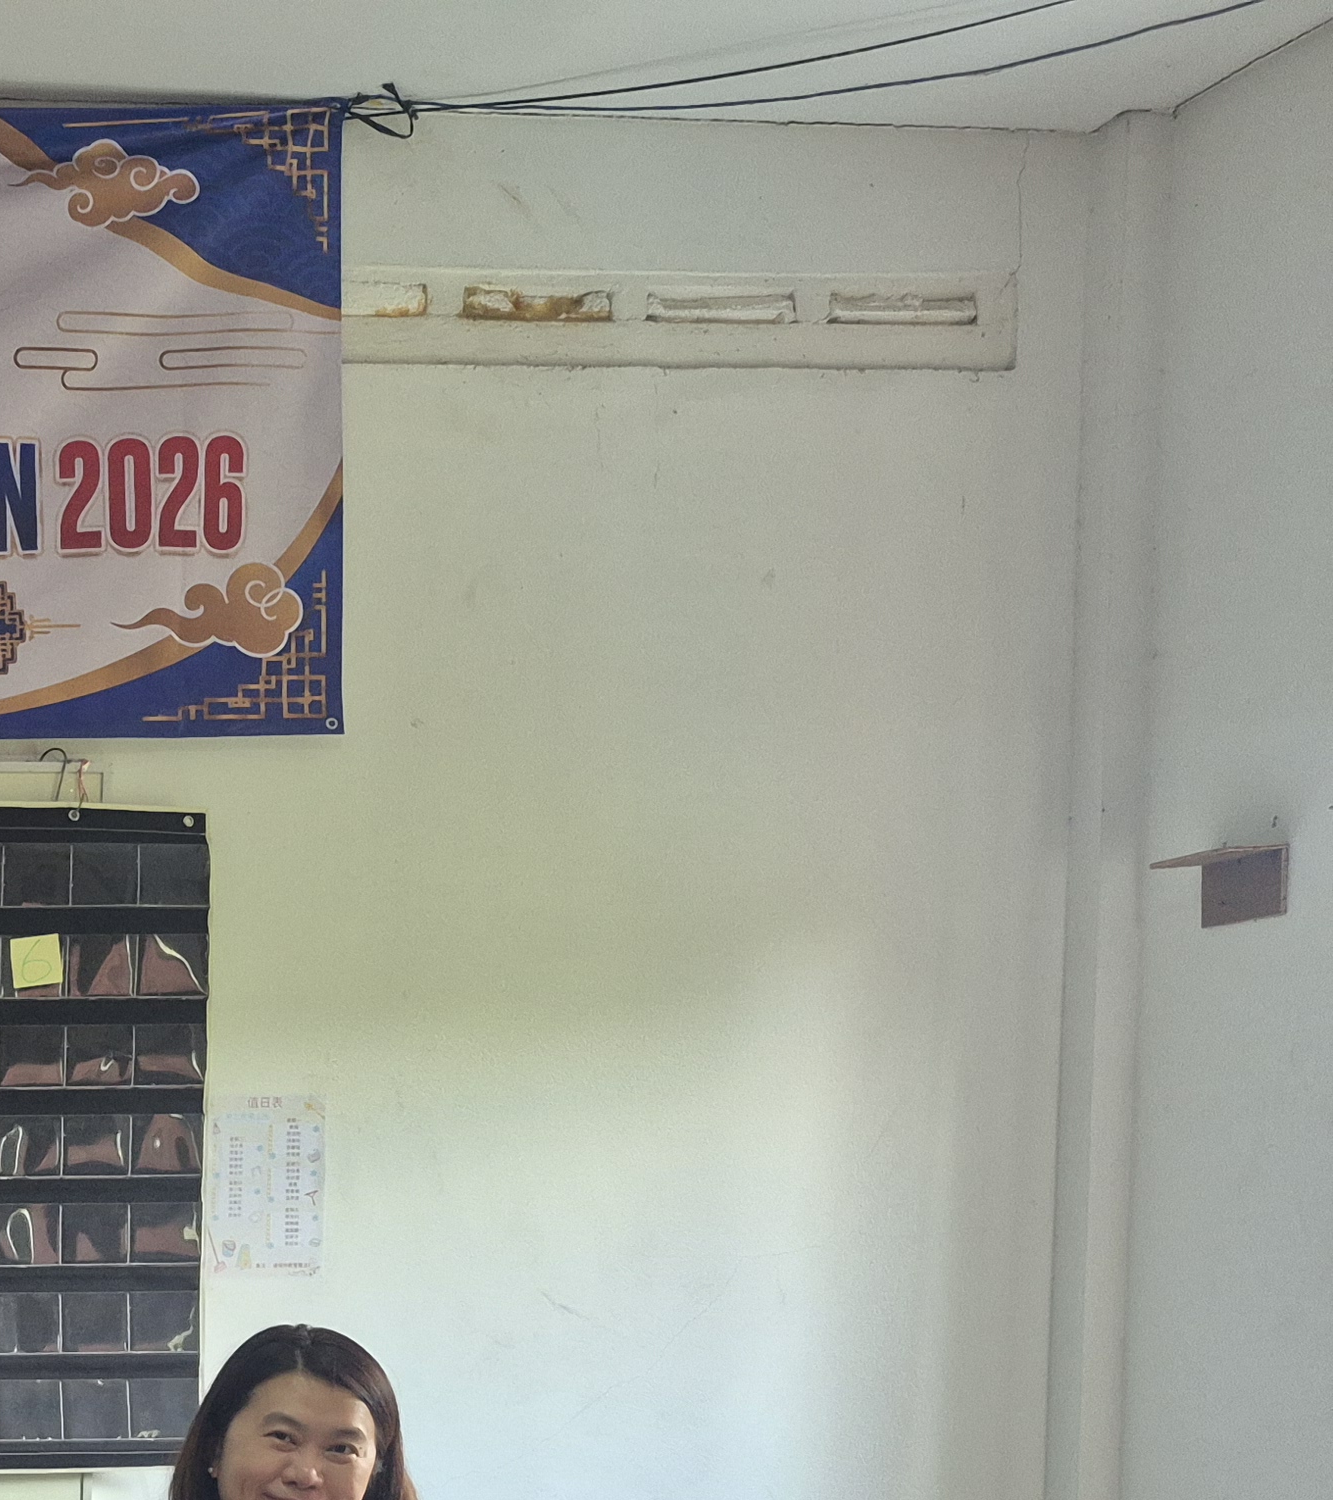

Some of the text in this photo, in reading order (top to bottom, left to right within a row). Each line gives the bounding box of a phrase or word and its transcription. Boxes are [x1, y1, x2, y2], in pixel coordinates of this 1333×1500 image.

[58, 435, 245, 553] 2026
[21, 938, 52, 983] 6
[247, 1096, 283, 1109] 值日表
